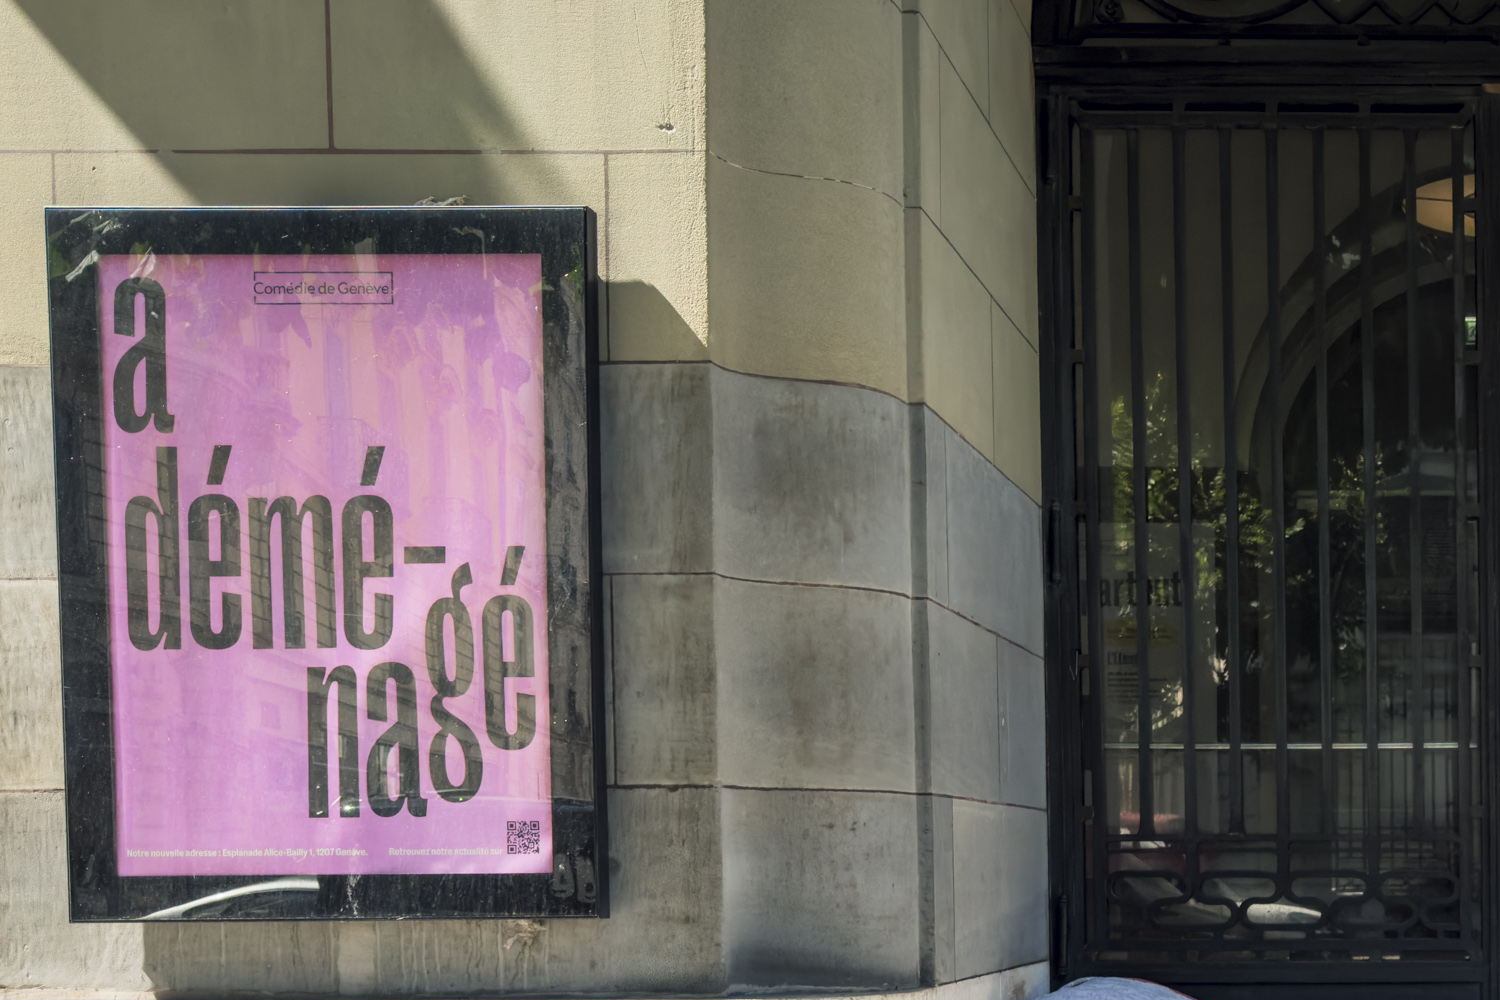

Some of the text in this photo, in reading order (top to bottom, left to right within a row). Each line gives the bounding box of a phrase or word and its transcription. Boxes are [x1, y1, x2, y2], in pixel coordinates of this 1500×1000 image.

[253, 282, 315, 294] Comédie
[318, 282, 335, 294] de
[113, 276, 175, 434] a
[307, 546, 537, 819] nagé
[127, 849, 149, 858] Notre
[151, 849, 184, 858] nouvelle
[185, 849, 217, 858] adresse
[222, 849, 263, 860] Esplanade
[316, 848, 334, 857] 1207
[389, 846, 503, 856] Retrouvez notre actualité sur
